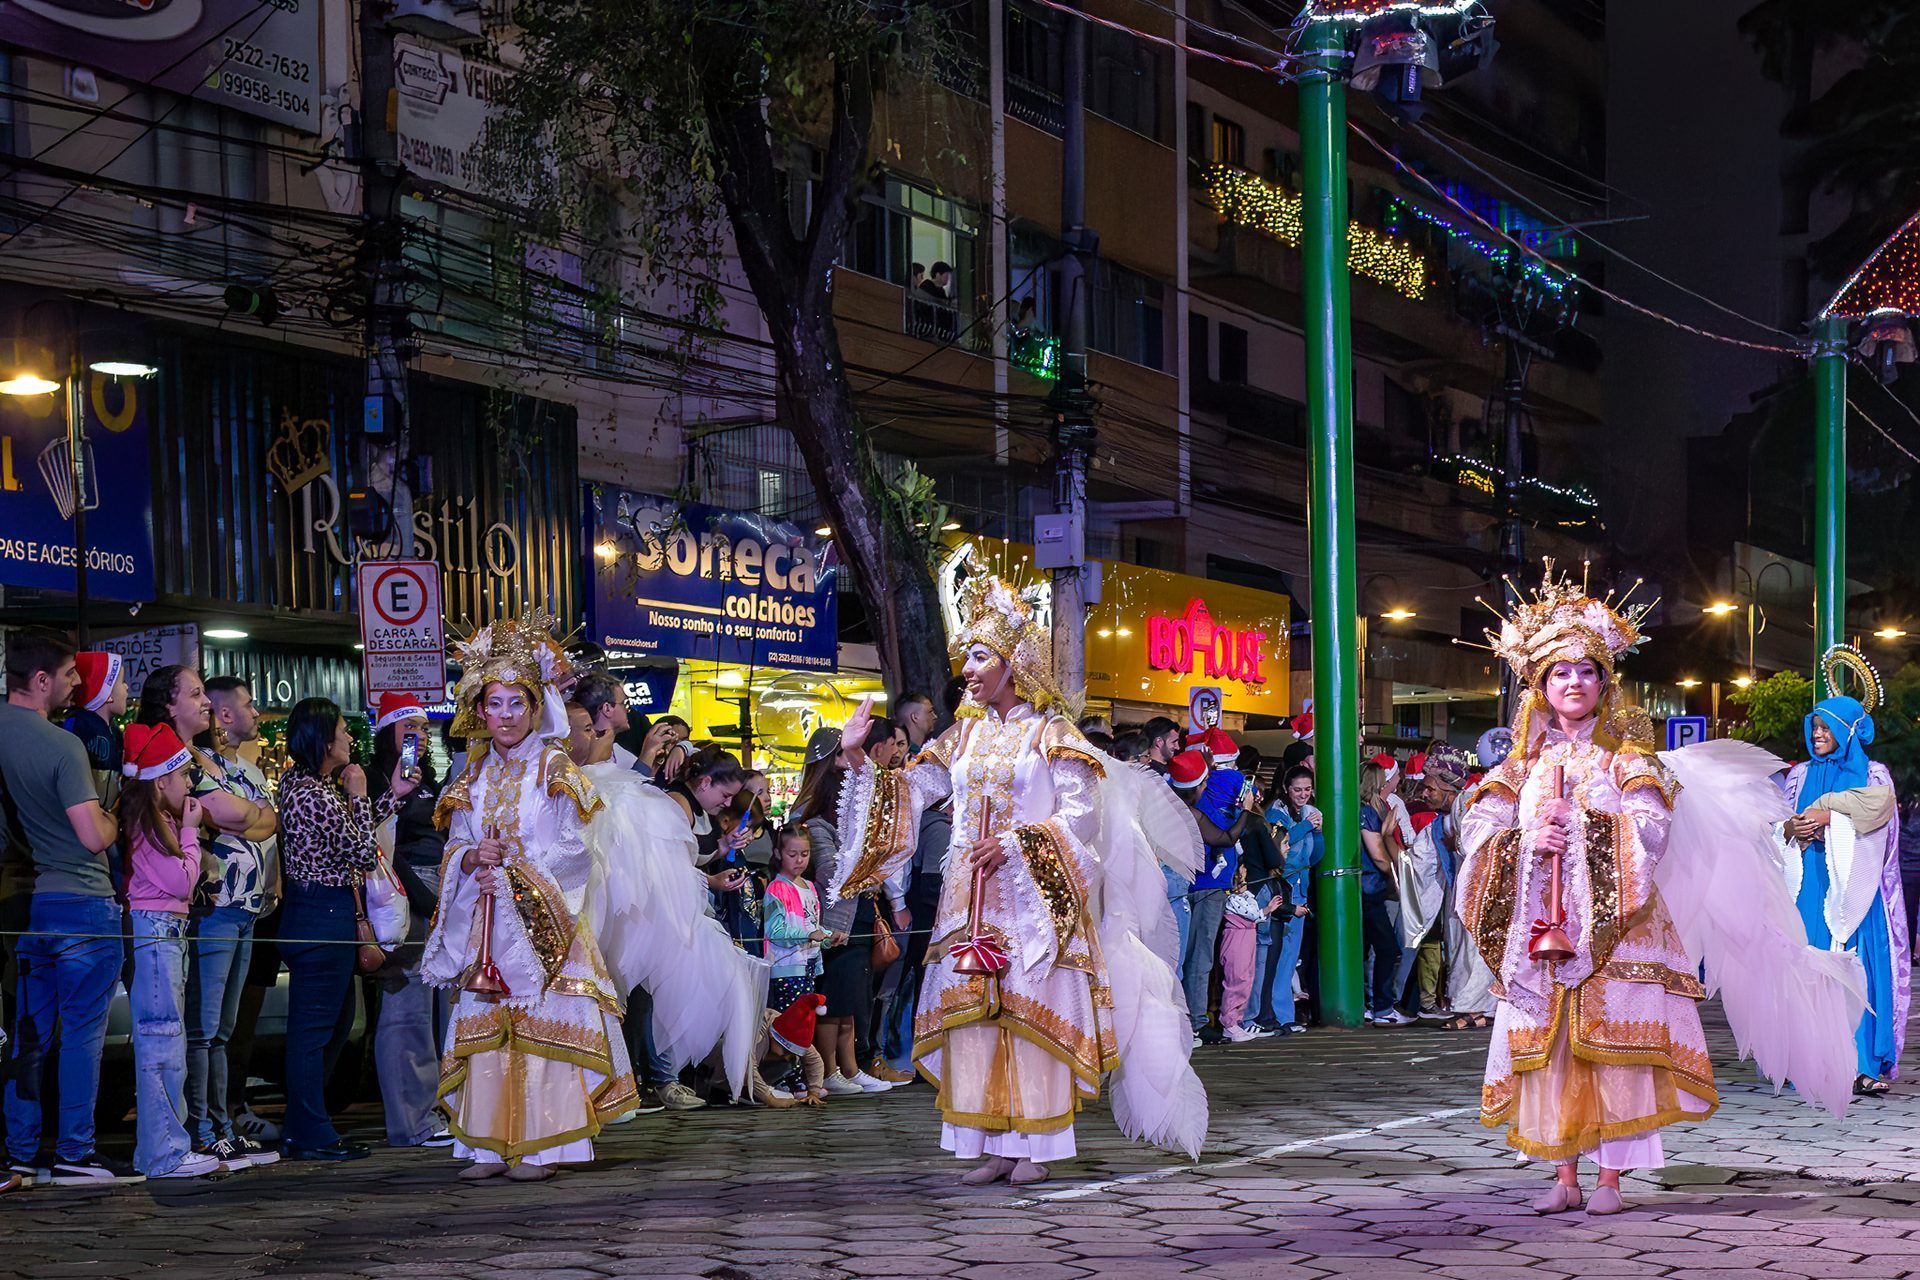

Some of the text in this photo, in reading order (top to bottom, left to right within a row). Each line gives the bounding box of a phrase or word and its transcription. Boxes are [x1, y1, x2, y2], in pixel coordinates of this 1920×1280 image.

[224, 38, 310, 83] 2522-7632
[224, 72, 310, 116] 99958-1504
[28, 542, 38, 563] E
[633, 506, 816, 593] Soneca
[391, 581, 409, 612] E
[725, 593, 816, 628] colchões
[374, 627, 432, 639] CARGA E
[649, 610, 680, 628] Nosso
[682, 614, 714, 634] sonho
[725, 624, 732, 635] o
[734, 625, 752, 638] seu
[756, 625, 797, 642] conforto
[369, 639, 437, 651] DESCARGA
[1680, 724, 1694, 748] P
